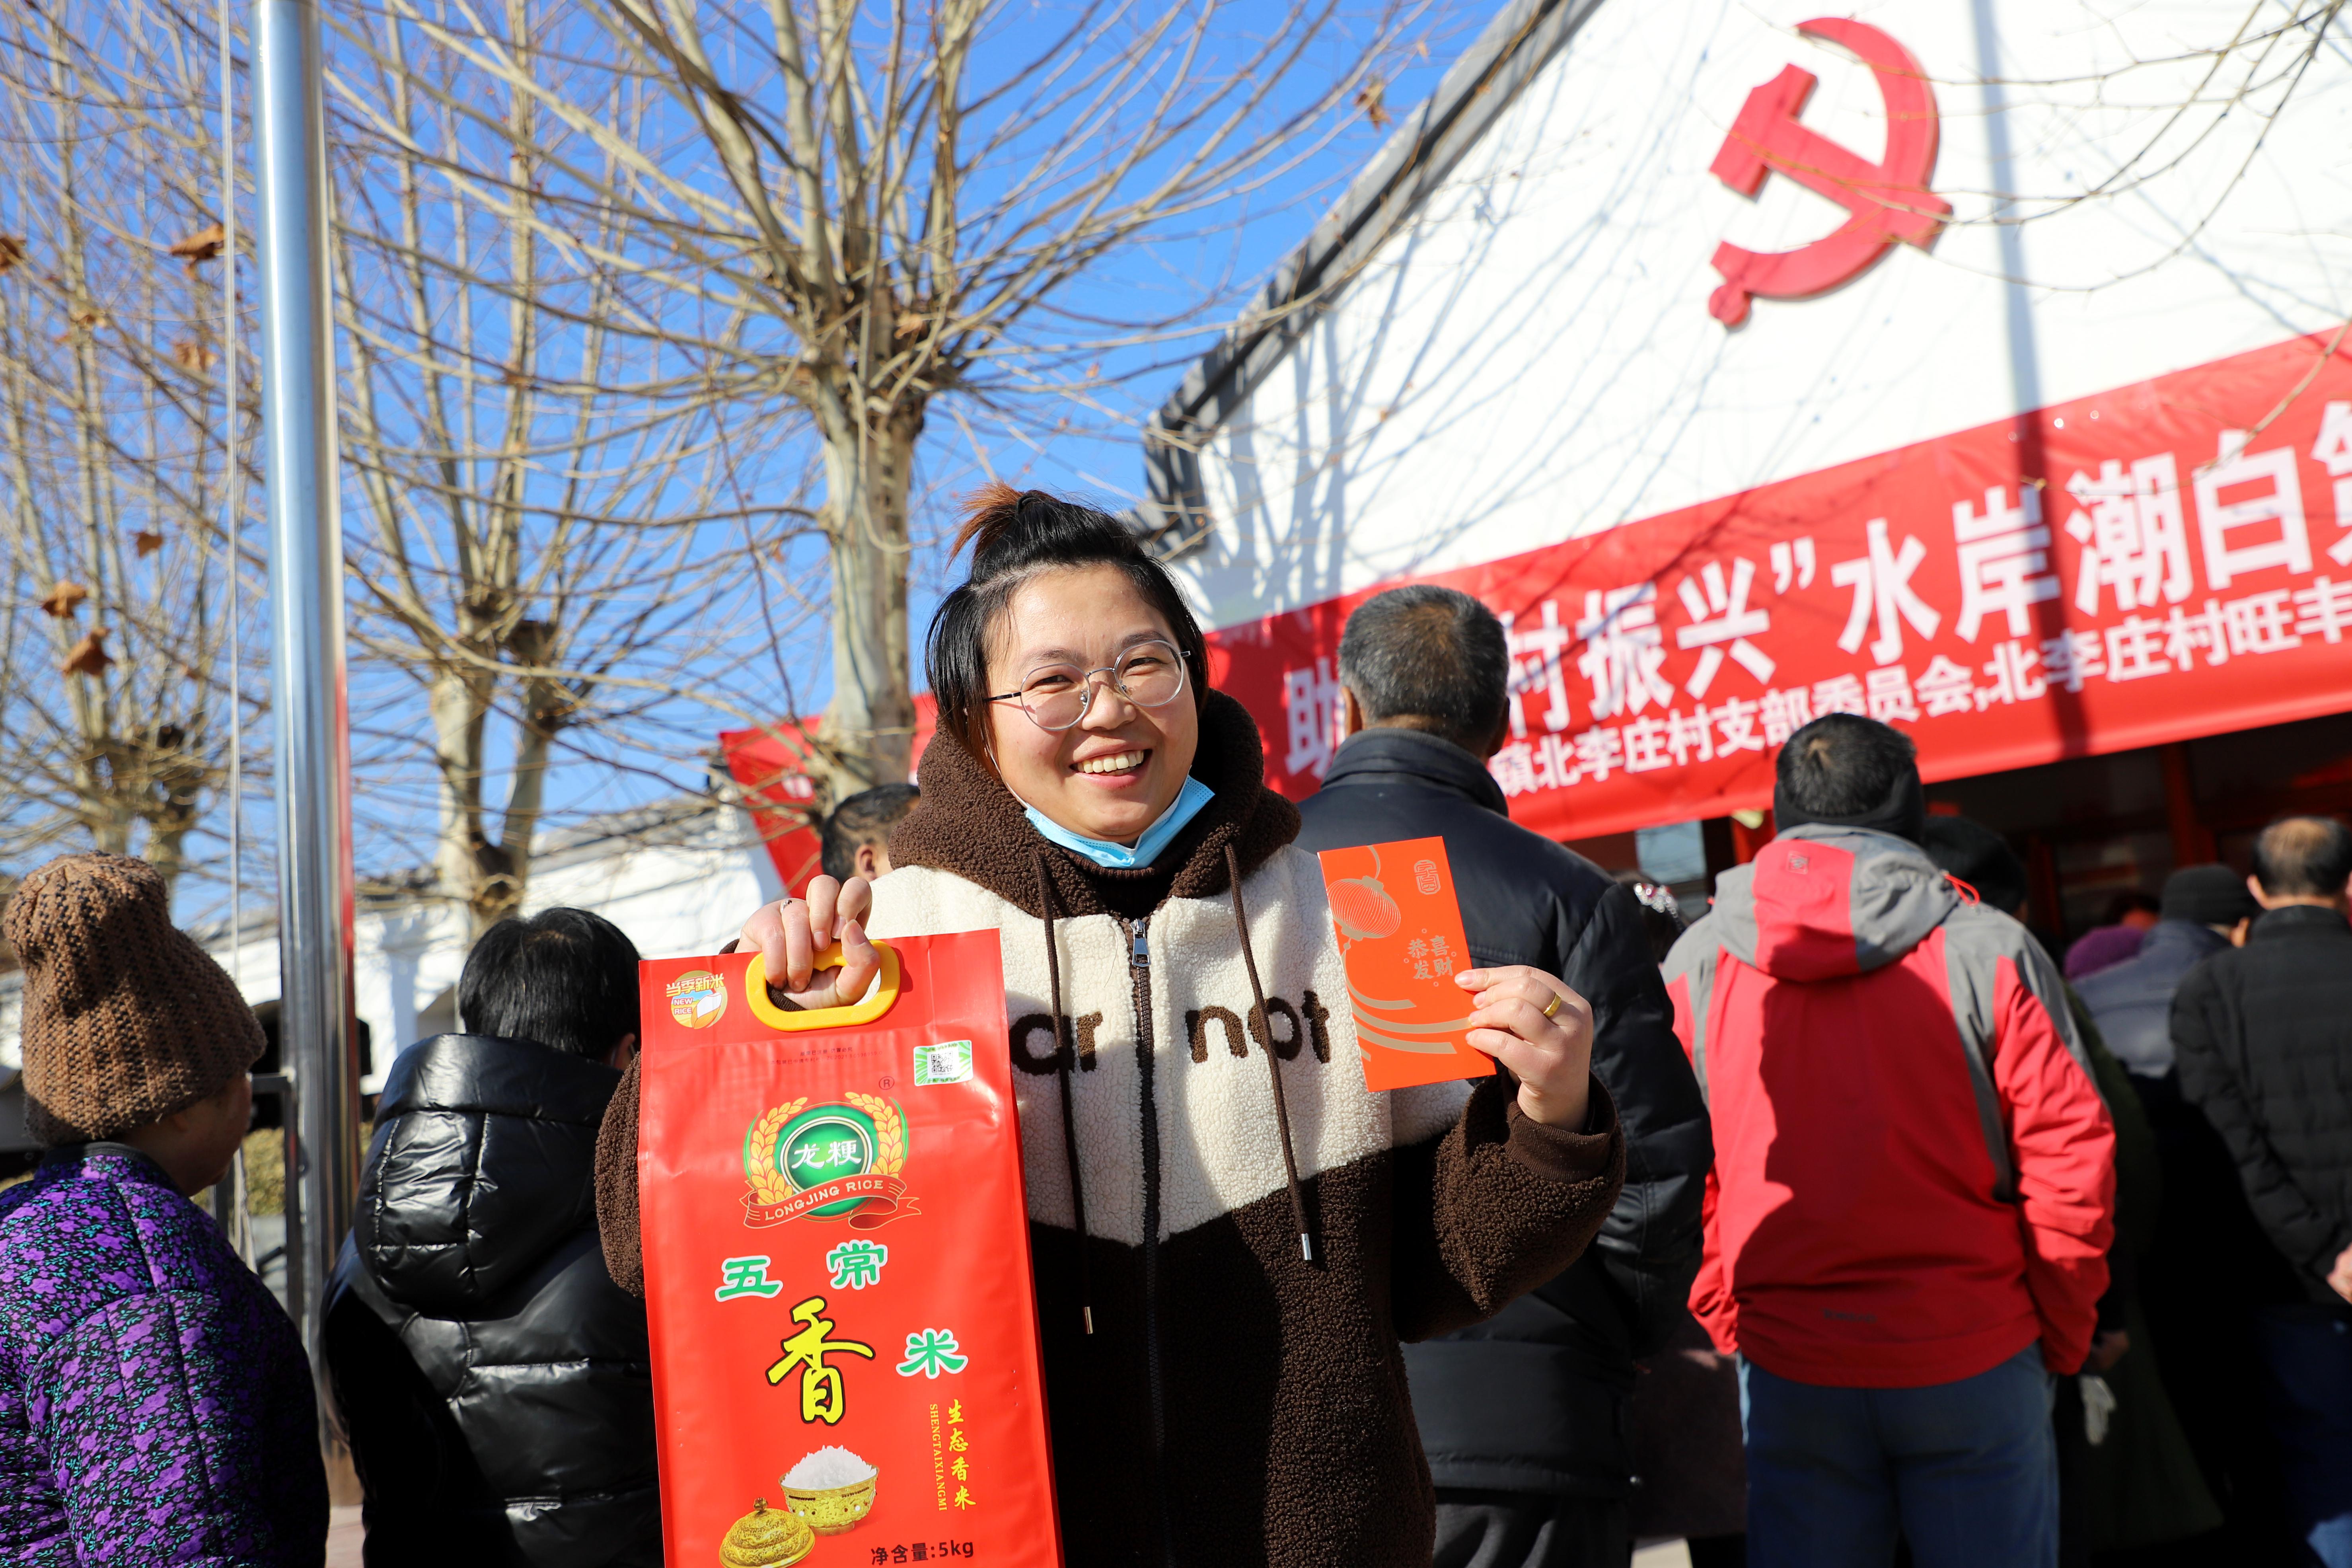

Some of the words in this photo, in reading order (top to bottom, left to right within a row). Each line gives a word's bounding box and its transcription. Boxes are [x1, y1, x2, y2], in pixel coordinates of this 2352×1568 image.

[666, 973, 724, 997] 当季新米
[1185, 990, 1331, 1064] not
[791, 1140, 862, 1169] 龙粳
[765, 1186, 840, 1221] LONGJING
[845, 1180, 884, 1192] RICE
[930, 1404, 947, 1511] SHENGTAIXIANGMI
[947, 1399, 976, 1511] 生态香米
[871, 1540, 974, 1566] 净含量:5kg
